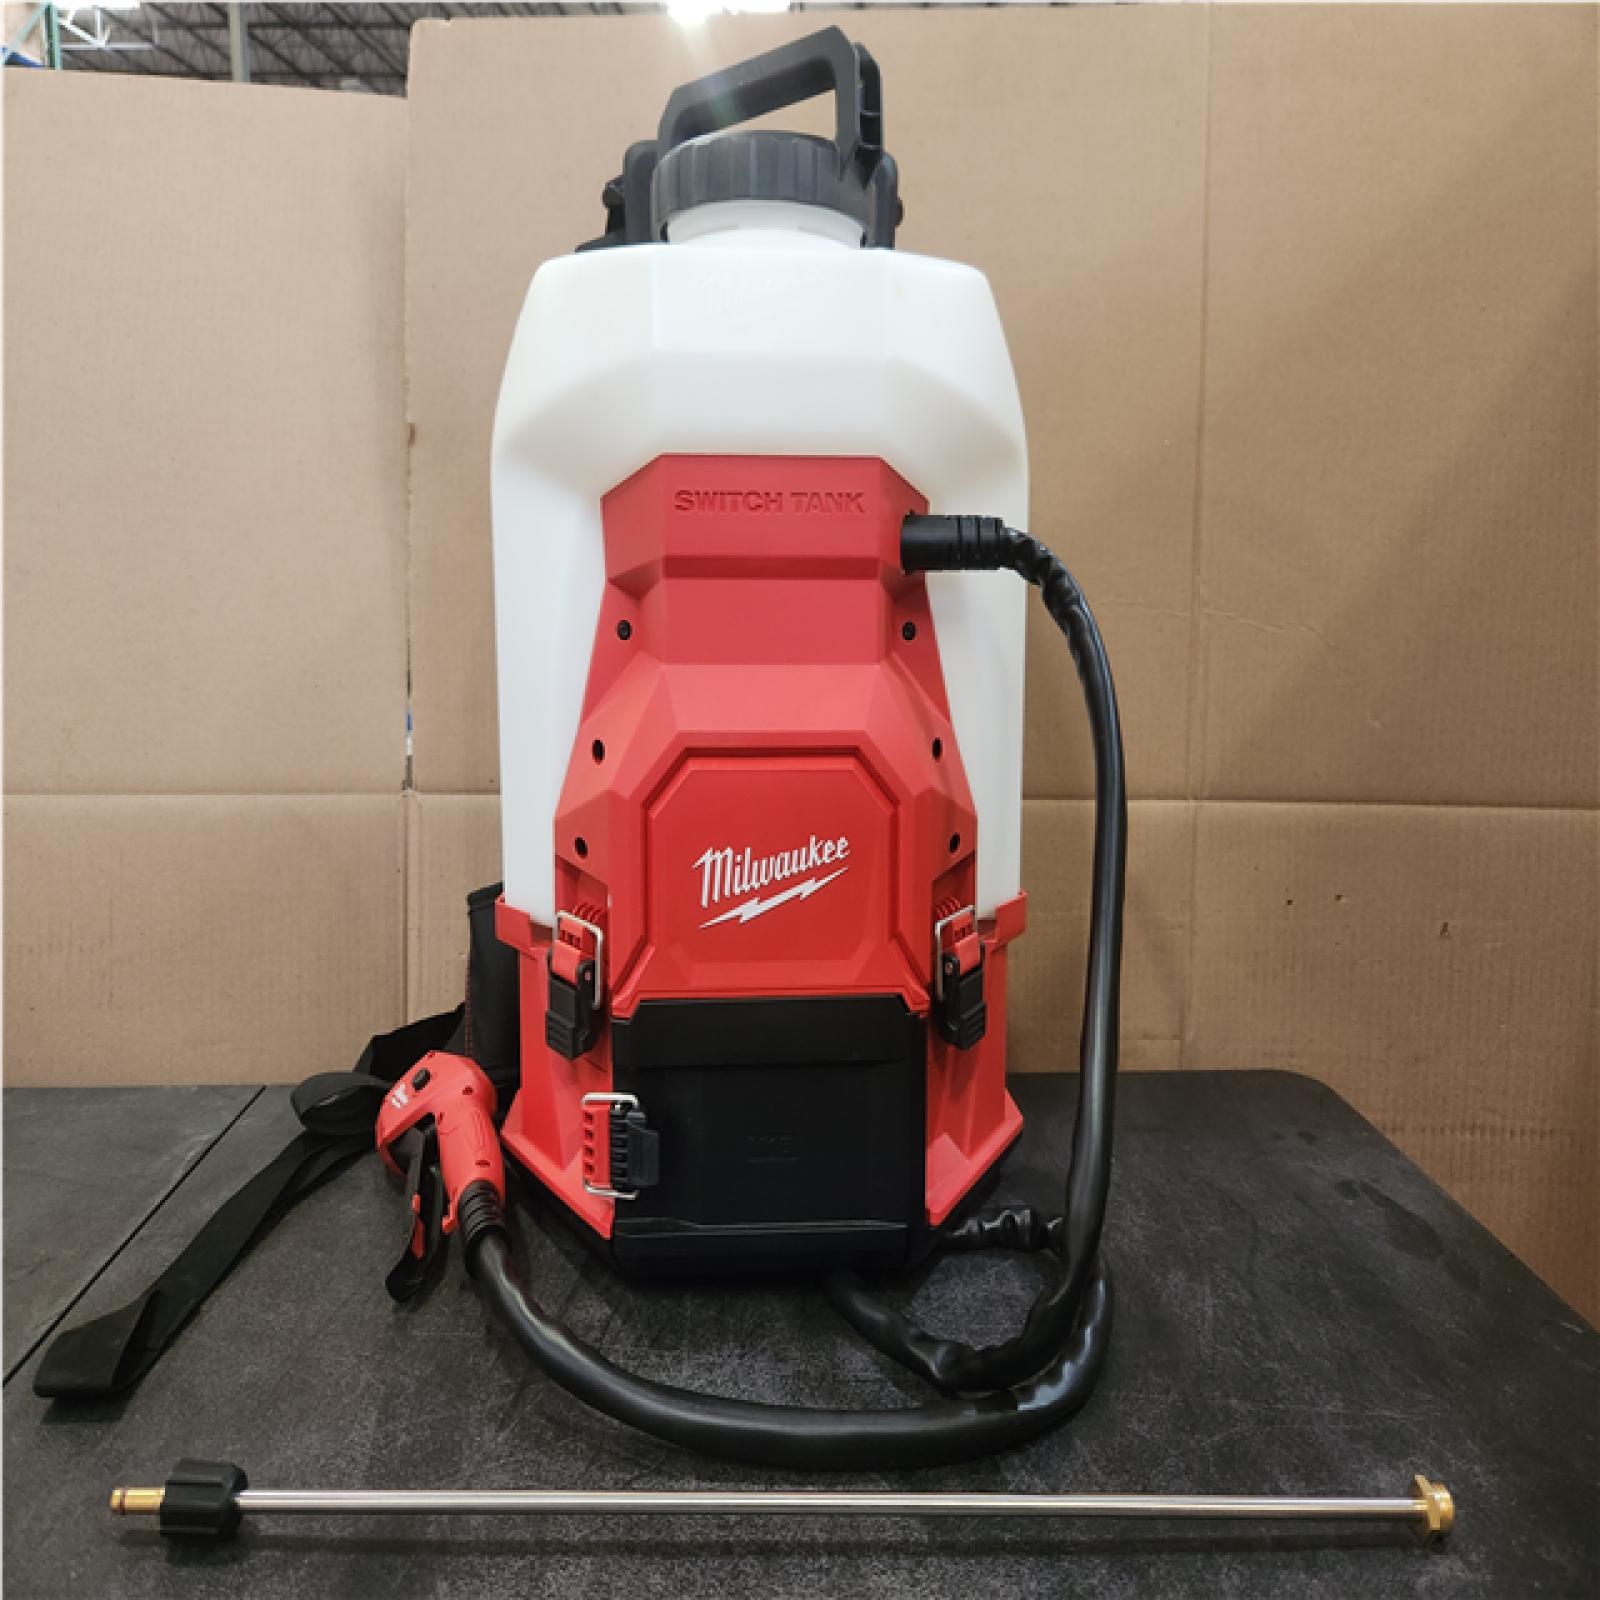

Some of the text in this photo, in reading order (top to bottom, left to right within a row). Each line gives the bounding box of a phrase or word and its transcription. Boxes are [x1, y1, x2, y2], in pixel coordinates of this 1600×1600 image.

[674, 489, 866, 514] SWITCH TANK
[692, 834, 851, 909] Milwaukee
